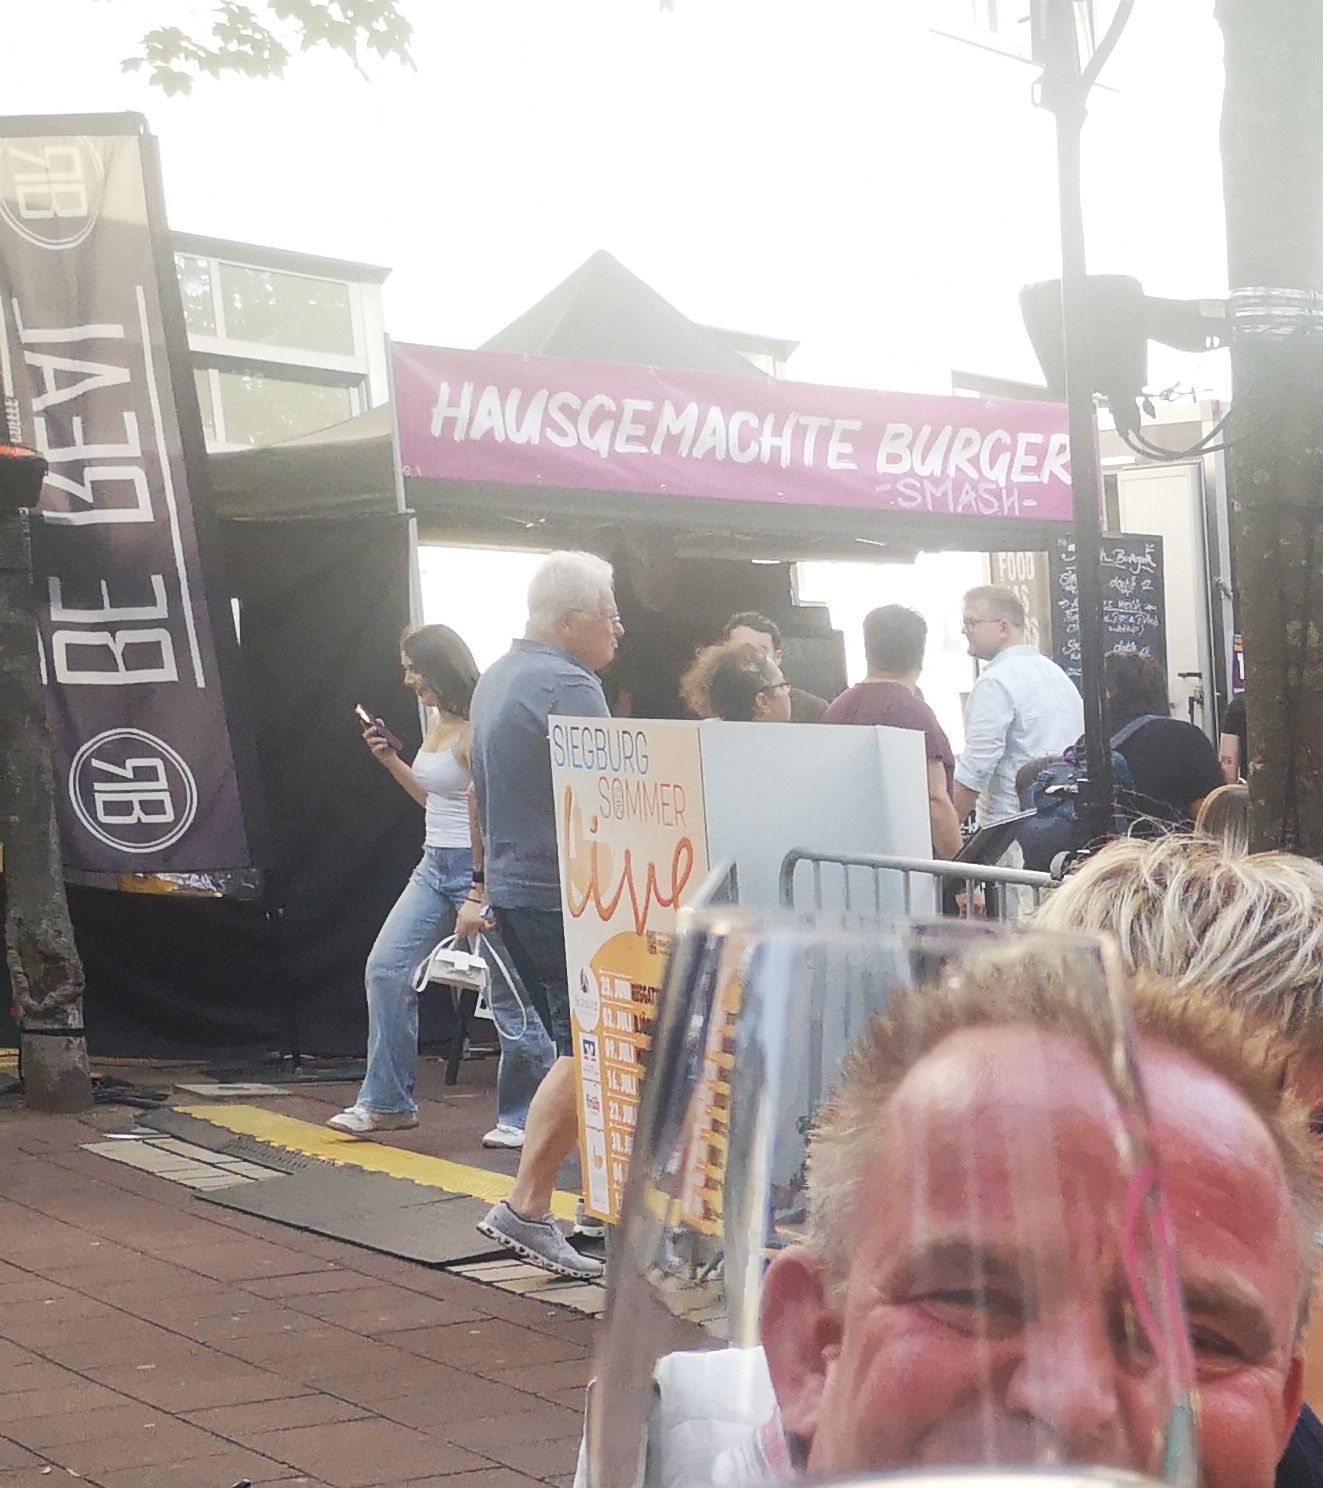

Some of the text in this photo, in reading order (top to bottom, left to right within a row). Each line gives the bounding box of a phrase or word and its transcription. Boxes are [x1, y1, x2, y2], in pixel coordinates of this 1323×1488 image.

[430, 381, 1072, 485] HAUSGEMACHTE BURGER
[553, 724, 649, 775] SIEGBURG
[598, 776, 687, 828] SOMMER
